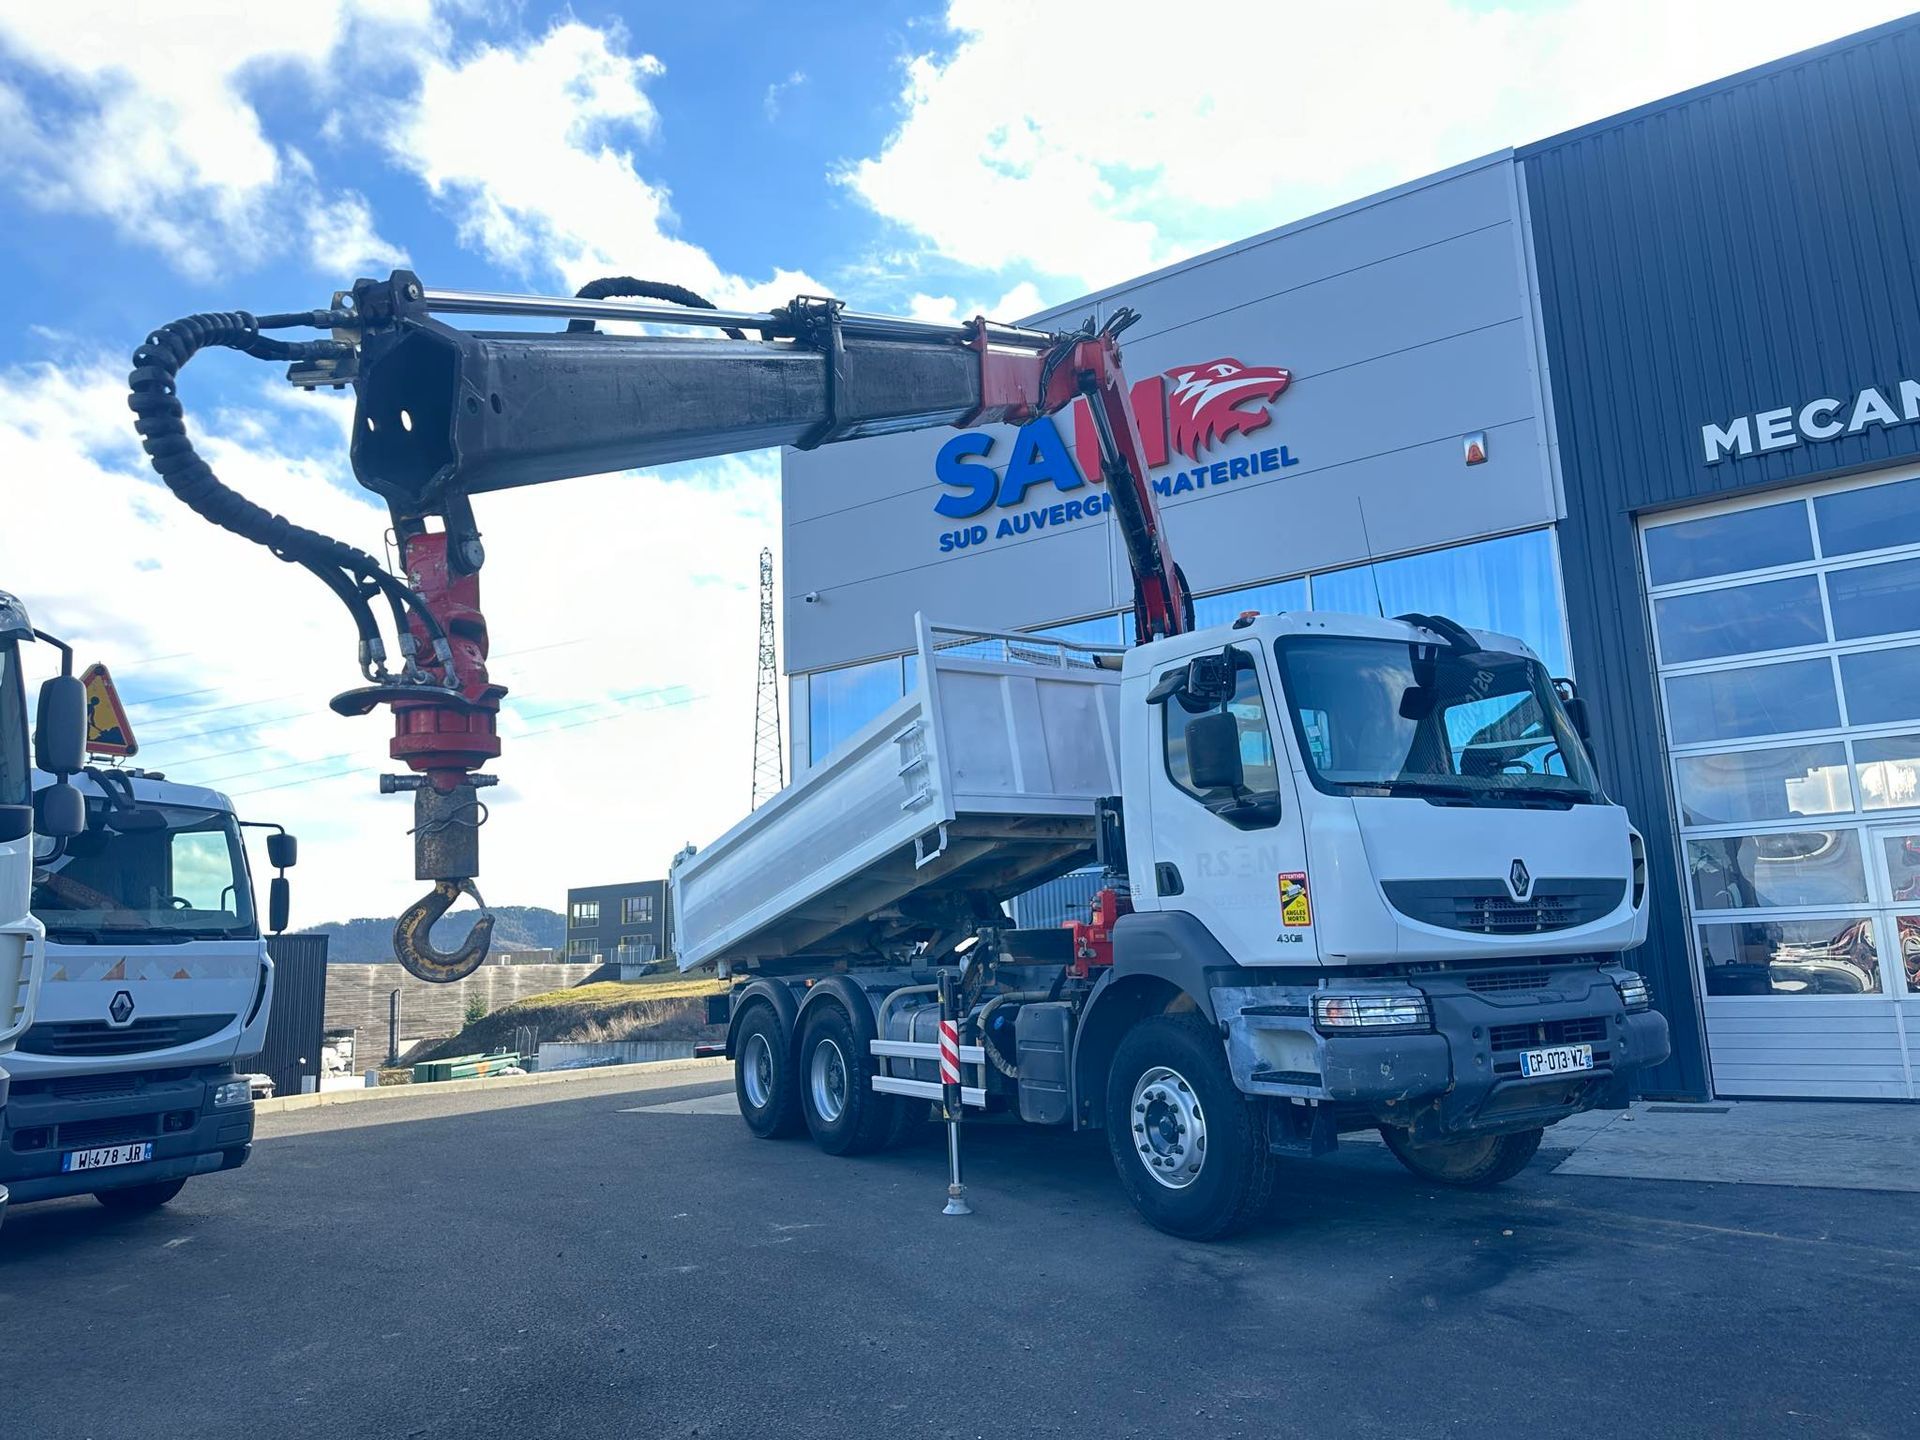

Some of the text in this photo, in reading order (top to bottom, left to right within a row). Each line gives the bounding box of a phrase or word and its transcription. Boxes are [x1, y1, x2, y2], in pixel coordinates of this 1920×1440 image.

[939, 445, 1299, 552] SUD AUVERGN MATERIEL
